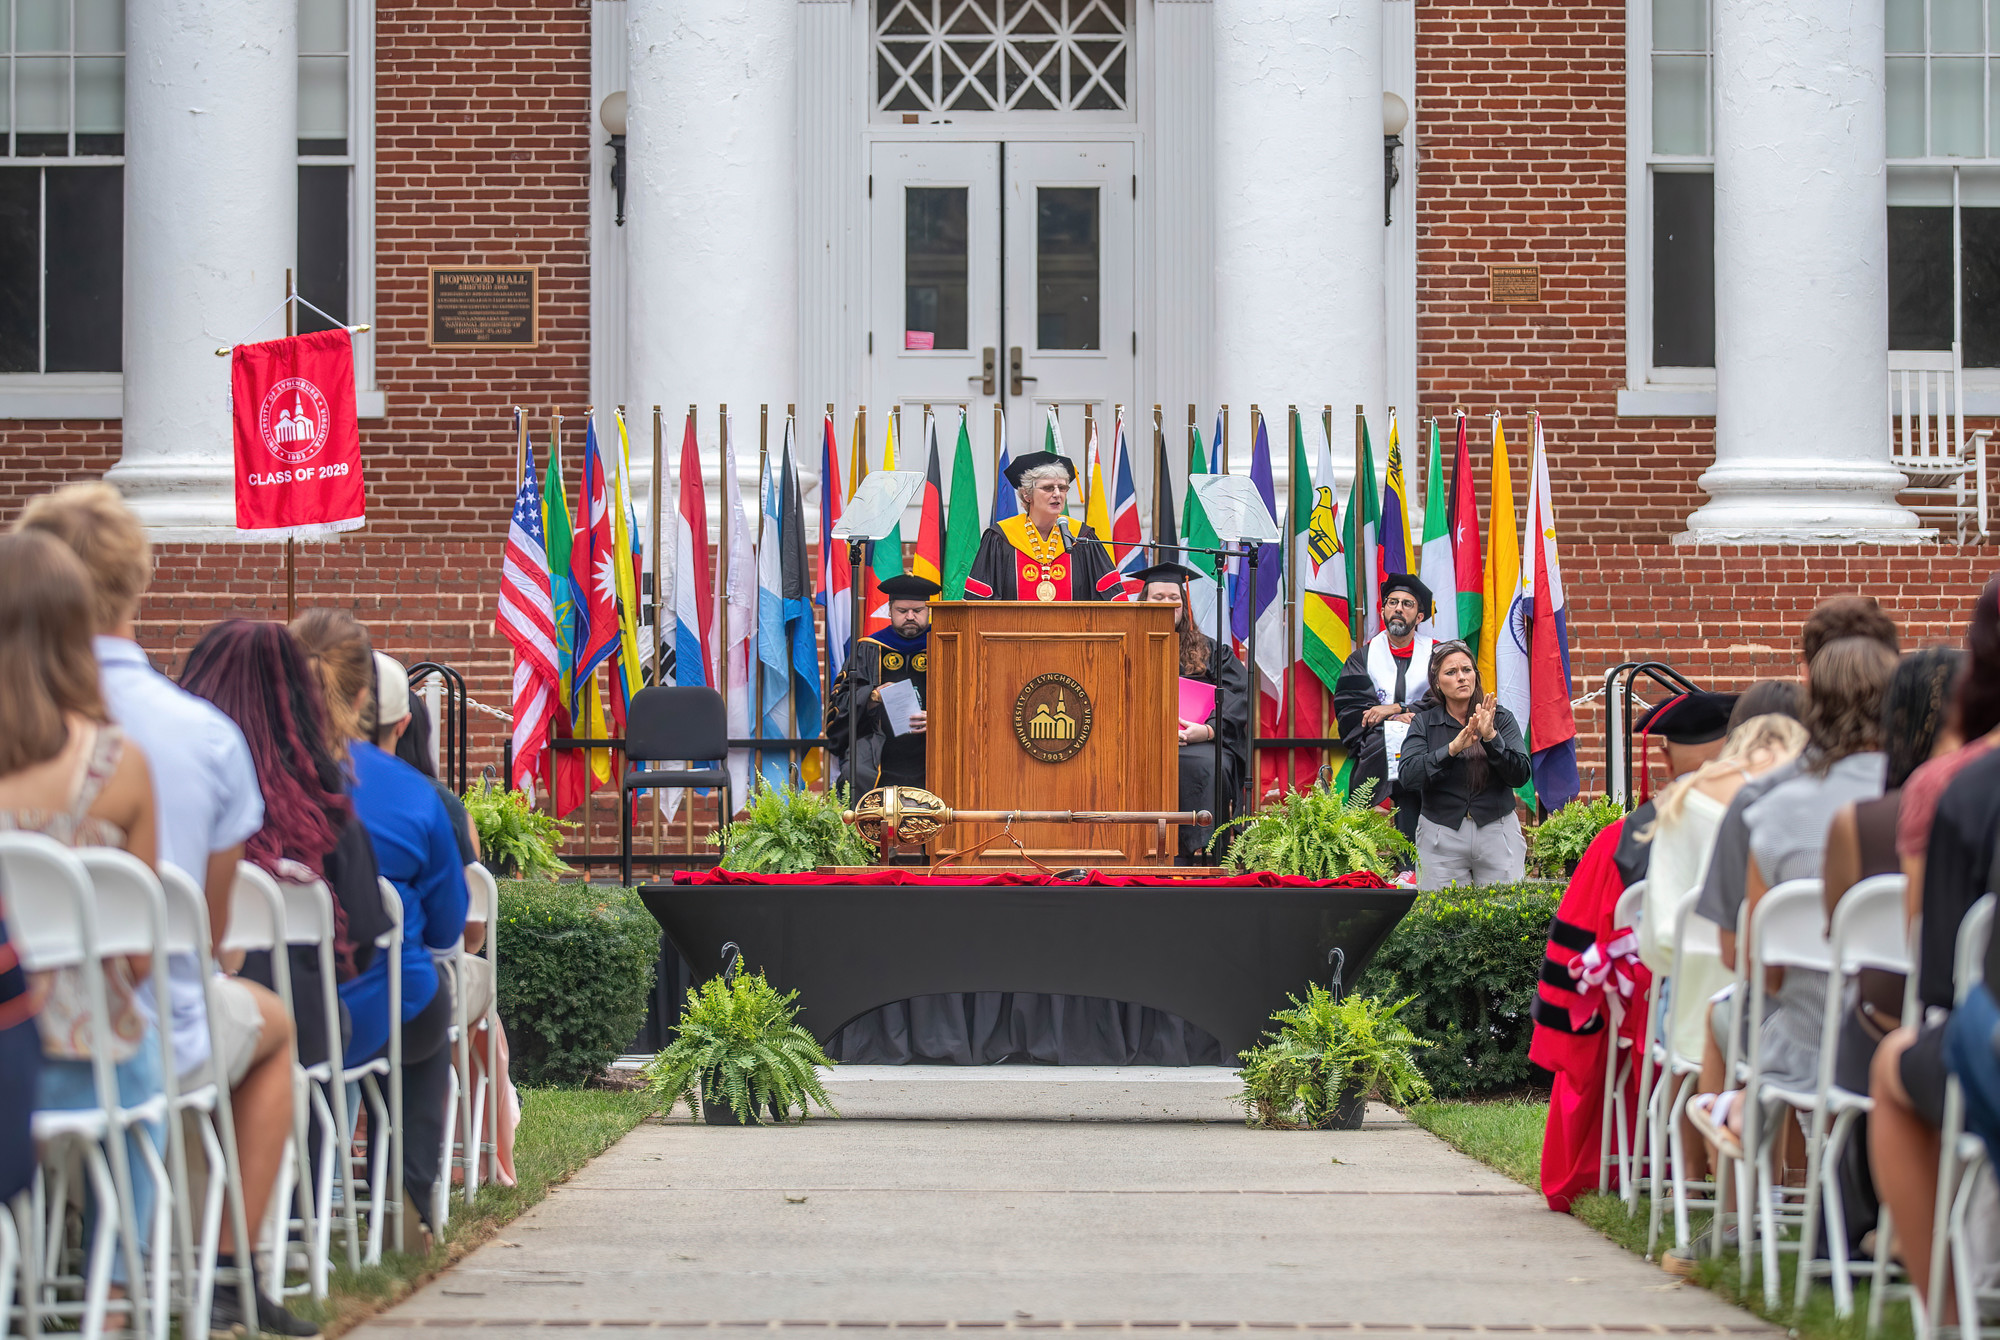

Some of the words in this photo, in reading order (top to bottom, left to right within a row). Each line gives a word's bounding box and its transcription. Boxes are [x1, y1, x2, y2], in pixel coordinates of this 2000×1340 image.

[440, 274, 495, 285] HOPWOOD
[497, 274, 528, 285] HALL
[248, 470, 292, 486] CLASS
[295, 468, 315, 481] OF
[319, 462, 349, 479] 2029
[1015, 695, 1031, 749] UNIVERSITY
[1024, 682, 1035, 694] OF
[1037, 674, 1086, 698] LYNCHBURG
[1073, 708, 1091, 749] VIRGINIA
[1042, 752, 1063, 760] 1903
